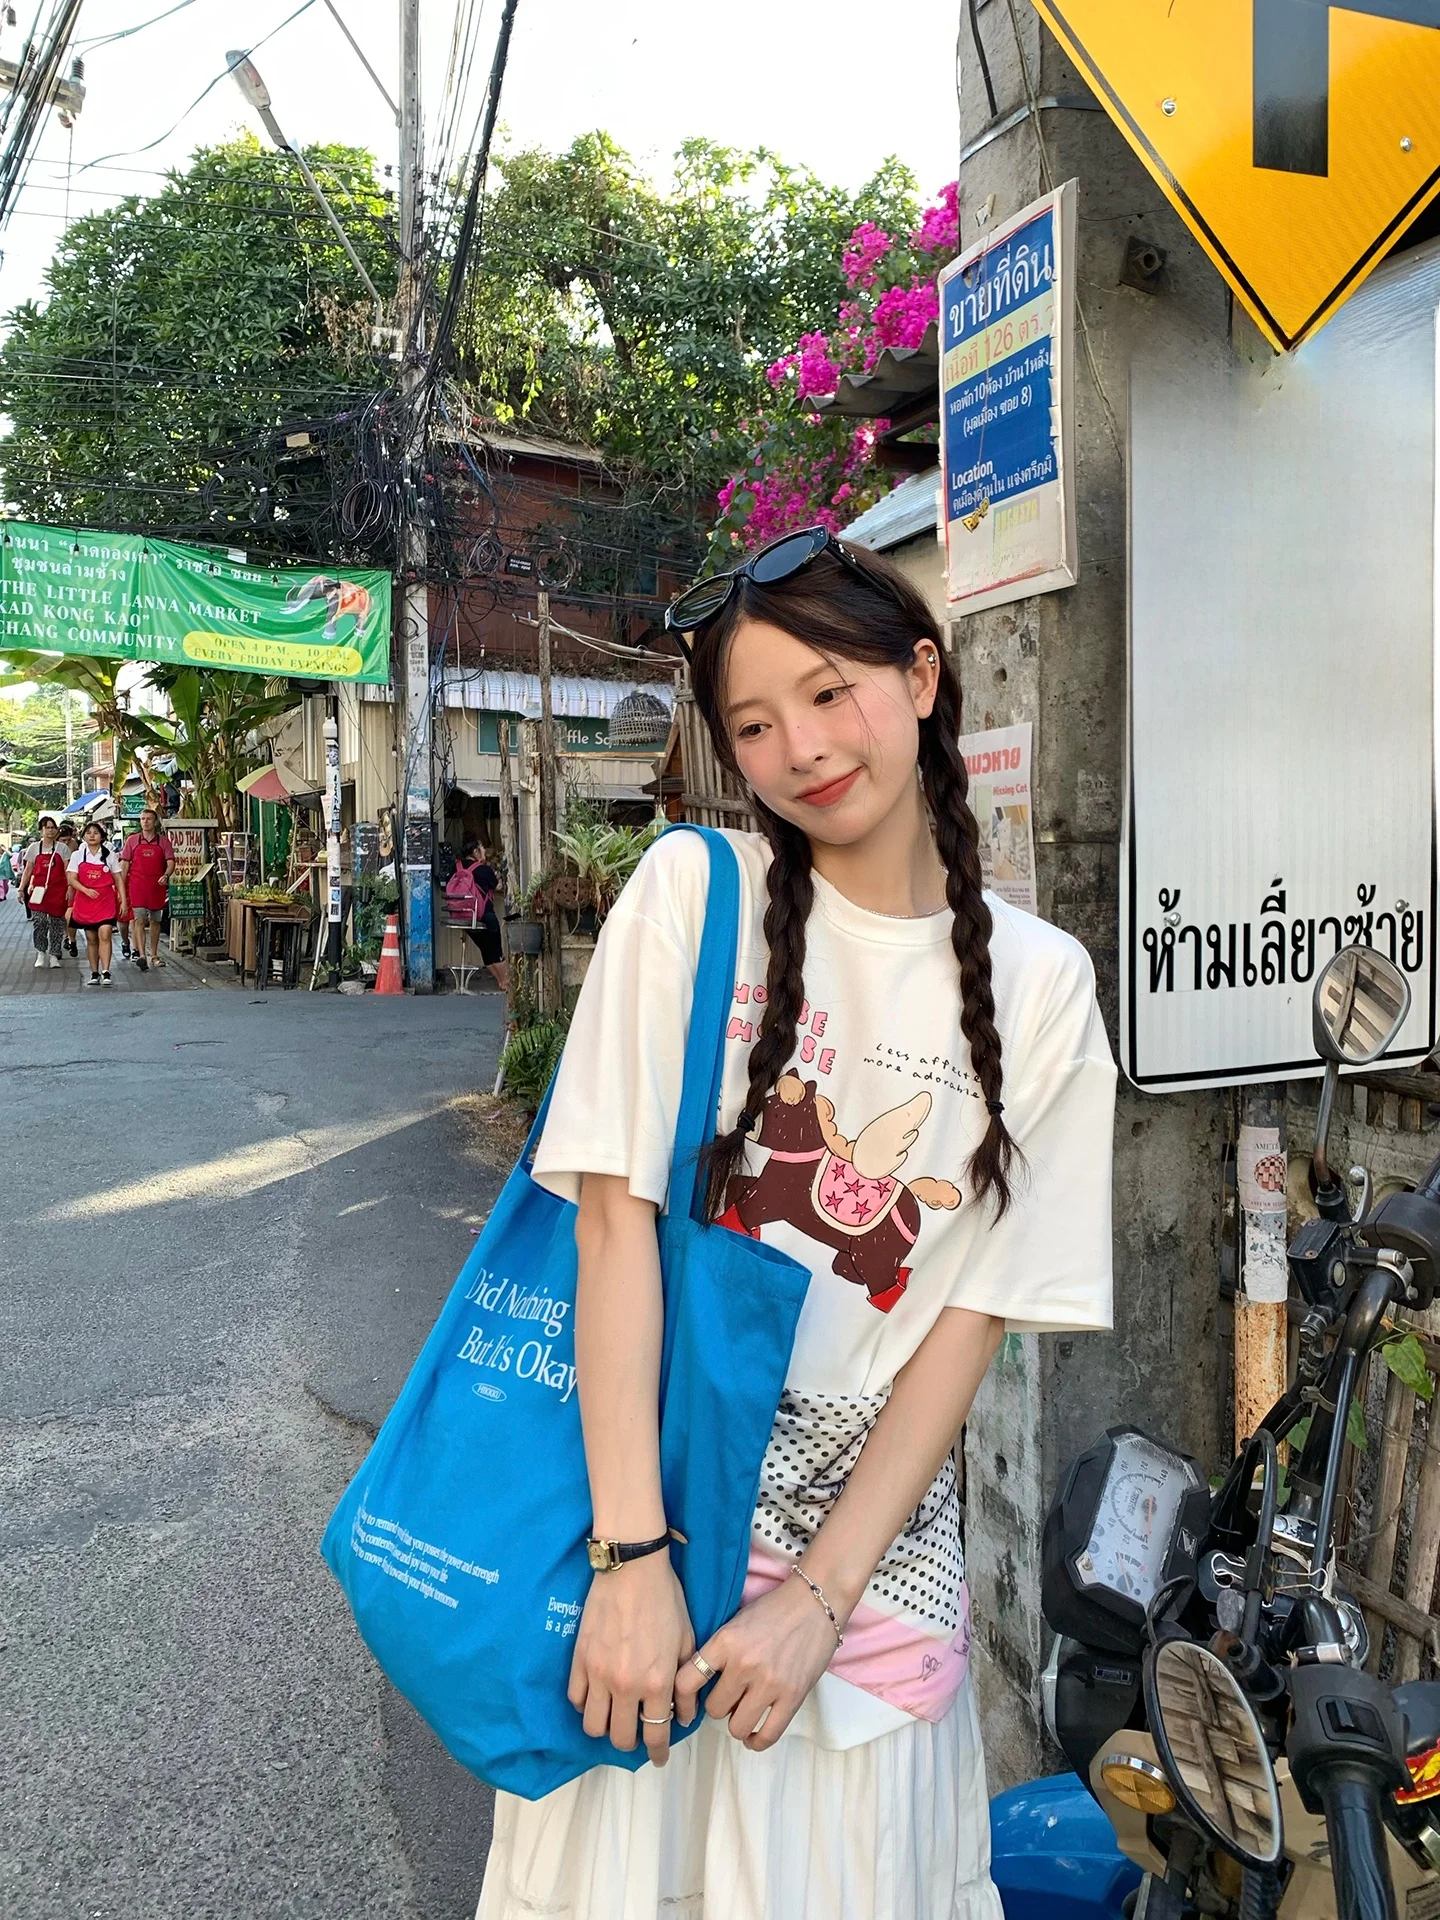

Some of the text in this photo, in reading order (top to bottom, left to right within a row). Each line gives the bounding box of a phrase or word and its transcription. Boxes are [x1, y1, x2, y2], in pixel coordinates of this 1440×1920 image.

[949, 243, 1050, 338] ขายที่ดิน
[1000, 395, 1018, 416] ซอย
[1021, 384, 1032, 407] 8)
[952, 460, 993, 490] Location
[1, 579, 262, 624] THE LITTLE LANNA MARKET
[43, 604, 95, 623] KONG
[68, 627, 177, 651] COMMUNITY
[214, 637, 246, 651] OPEN
[252, 643, 258, 652] 4
[264, 645, 290, 655] P.M.
[308, 648, 320, 657] 10
[194, 648, 349, 673] EVERY FRIDAY EVENINGS
[993, 783, 1028, 796] Missing Cat
[863, 1057, 980, 1099] more adorable
[920, 1056, 982, 1083] affecte
[464, 1267, 510, 1312] Did
[456, 1325, 494, 1366] But
[515, 1340, 578, 1404] Okay
[1160, 1469, 1169, 1481] 140
[1107, 1517, 1117, 1529] 40
[1122, 1534, 1131, 1545] 20
[363, 1551, 383, 1567] move
[460, 1560, 474, 1575] and
[471, 1564, 500, 1585] strength
[547, 1596, 584, 1620] Everyday
[544, 1615, 577, 1638] is a gift
